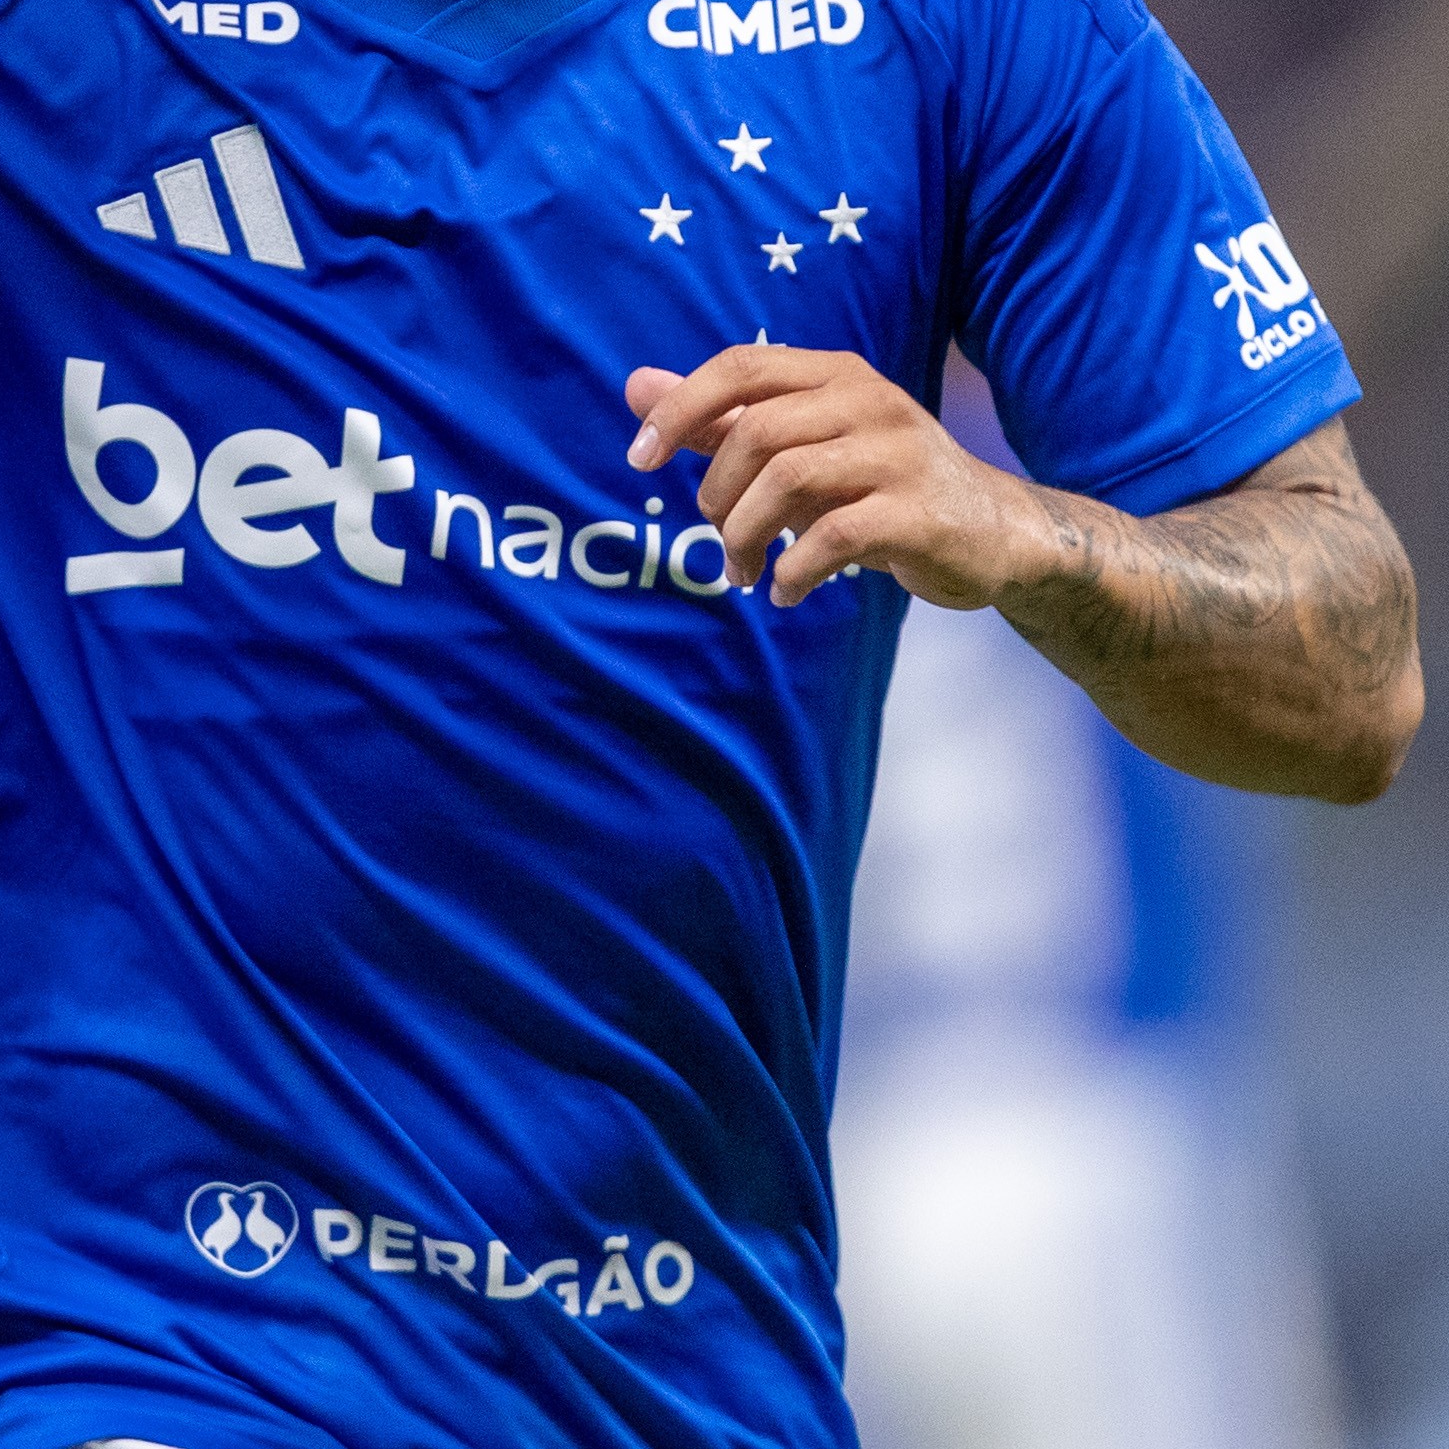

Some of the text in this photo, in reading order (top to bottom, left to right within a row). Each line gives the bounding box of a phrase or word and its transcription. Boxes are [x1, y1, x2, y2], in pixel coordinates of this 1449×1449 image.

[62, 356, 862, 597] bet nacio
[312, 1207, 695, 1318] PERDGÃO
